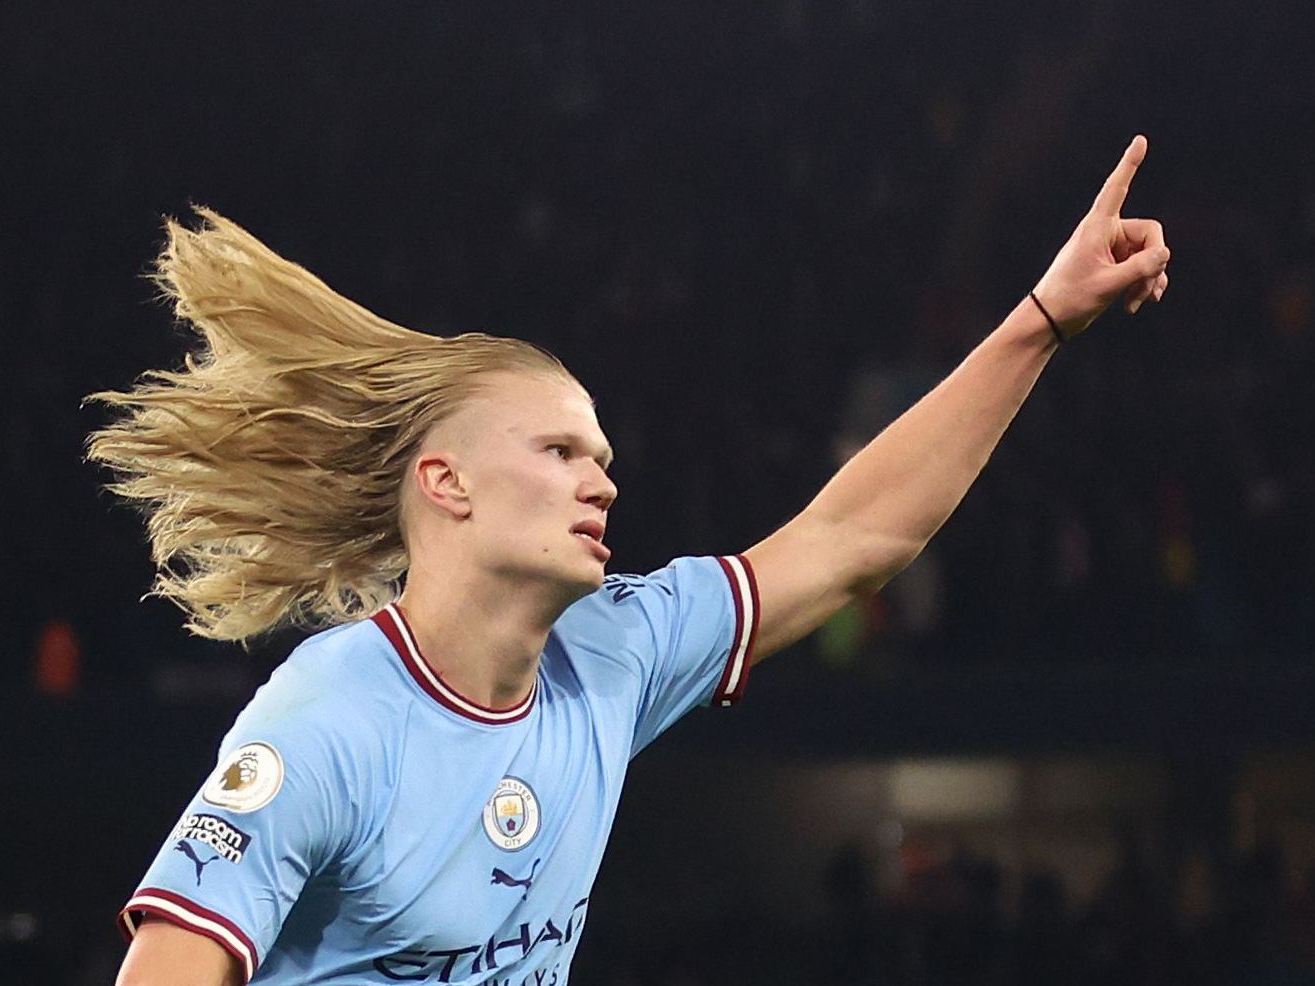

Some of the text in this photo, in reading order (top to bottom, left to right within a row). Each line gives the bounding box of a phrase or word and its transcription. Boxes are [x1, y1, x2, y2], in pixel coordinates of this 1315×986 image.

[190, 828, 243, 864] racism
[197, 816, 242, 848] room
[505, 837, 521, 848] CITY
